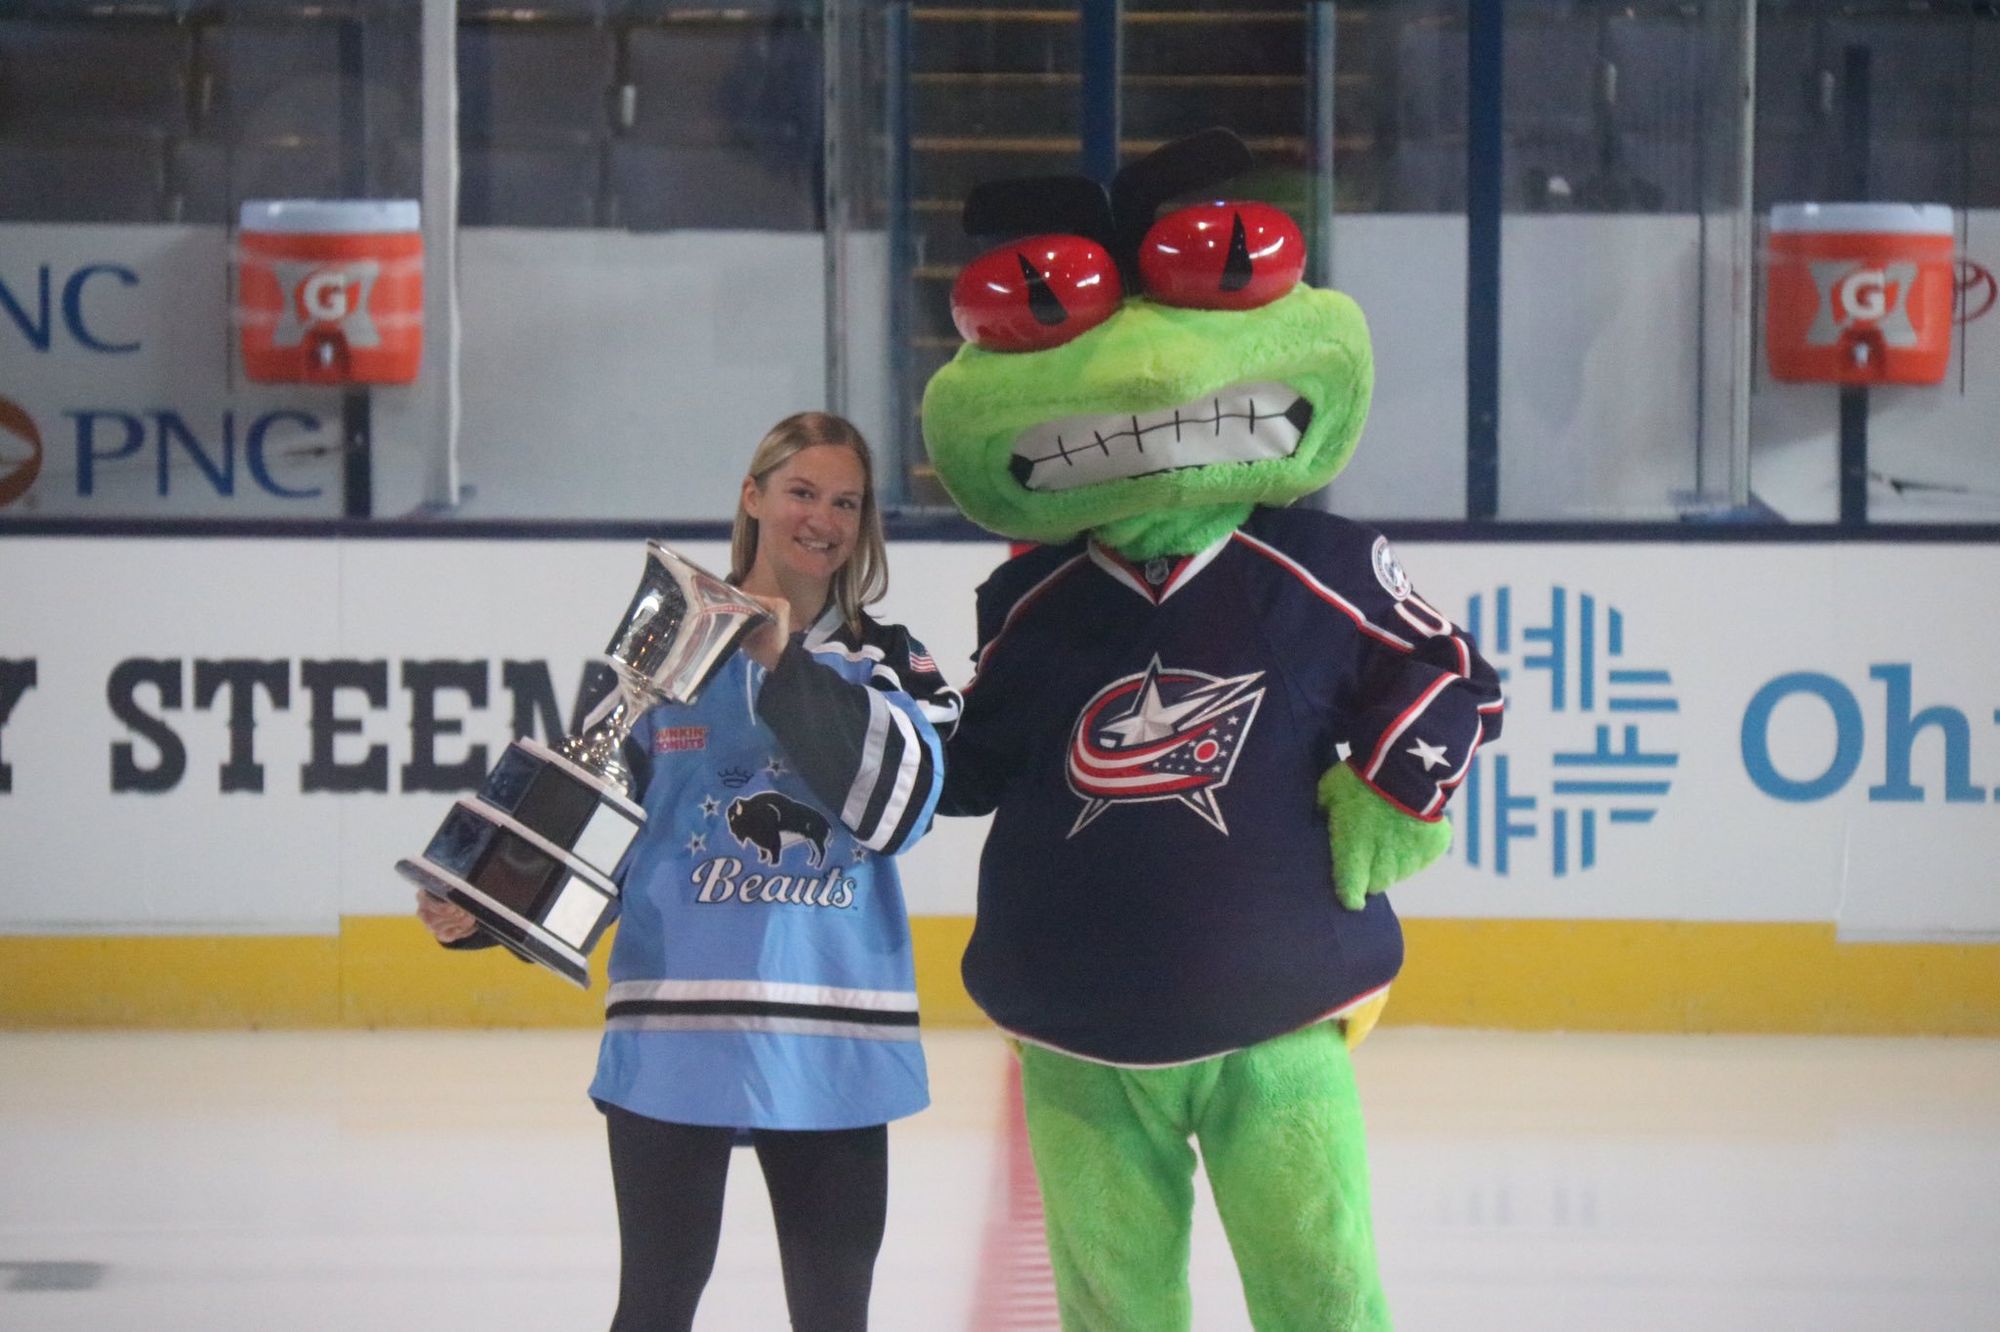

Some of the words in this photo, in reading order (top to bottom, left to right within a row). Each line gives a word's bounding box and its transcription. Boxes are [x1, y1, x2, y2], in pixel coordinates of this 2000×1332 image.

[304, 273, 347, 320] G
[1841, 271, 1886, 320] G
[62, 408, 322, 499] PNC
[1741, 662, 2000, 803] Oh
[691, 856, 856, 908] Beauts
